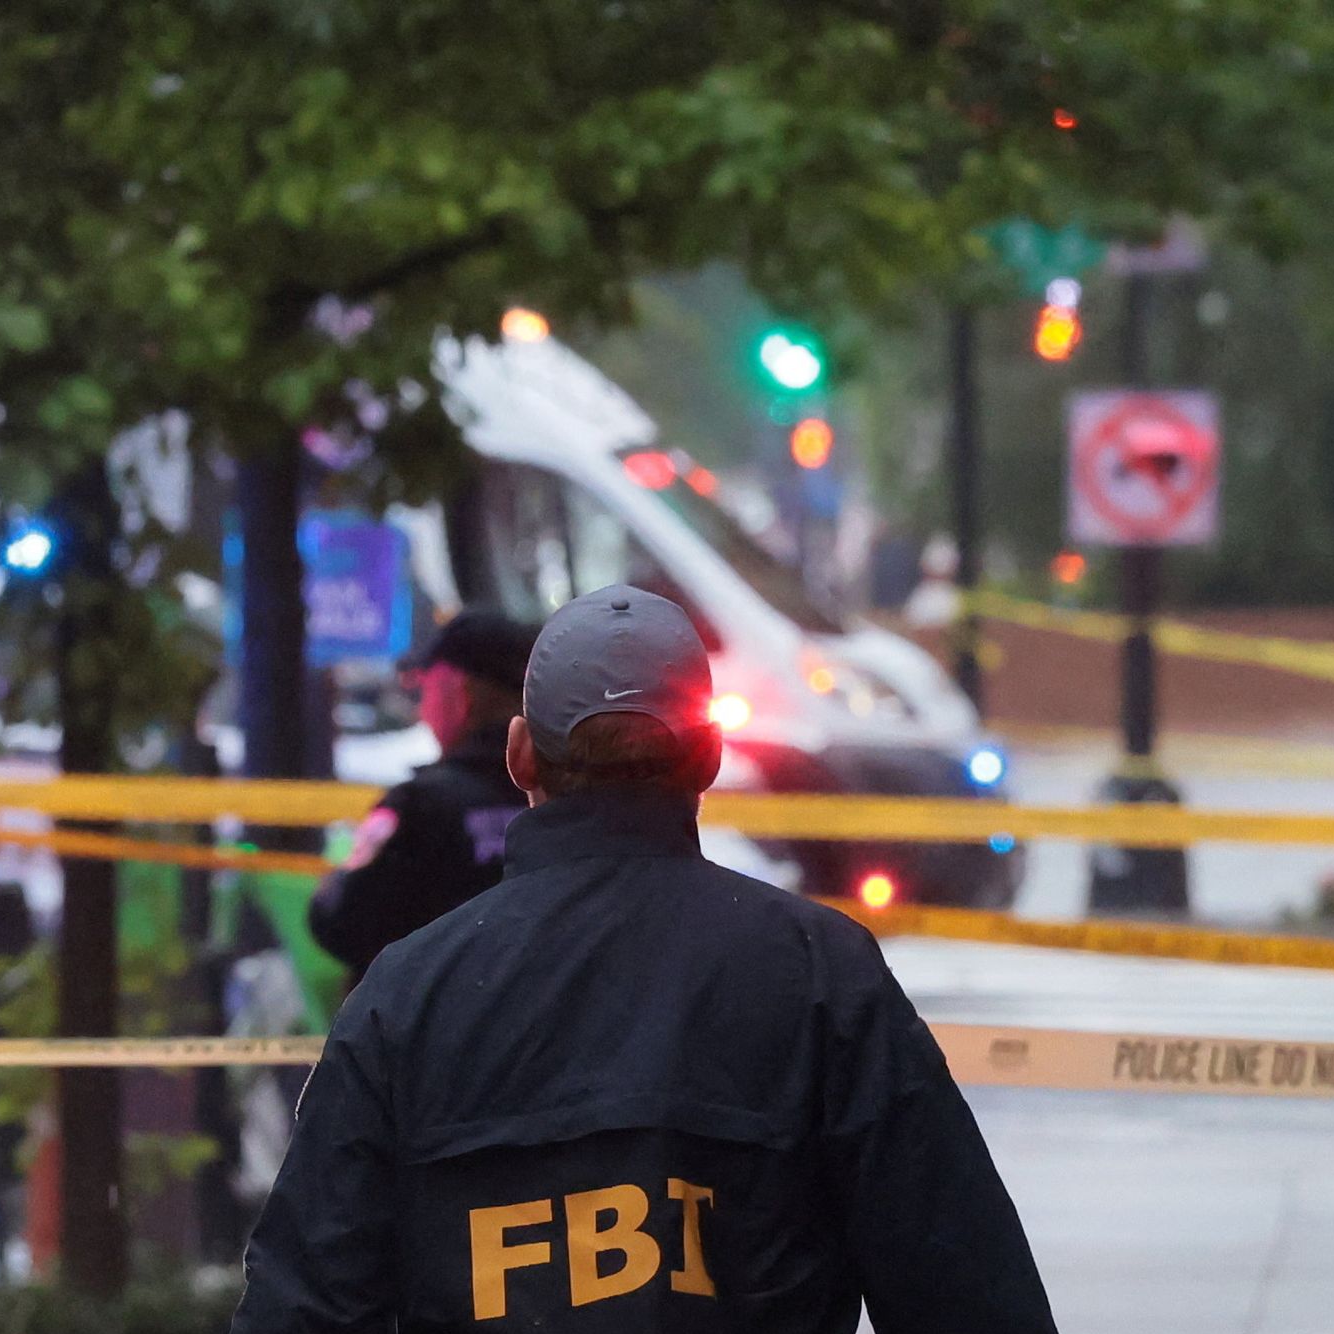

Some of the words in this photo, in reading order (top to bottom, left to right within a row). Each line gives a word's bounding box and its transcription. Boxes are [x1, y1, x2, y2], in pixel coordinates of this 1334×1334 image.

[1113, 1038, 1199, 1084] POLICE
[1207, 1043, 1261, 1086] LINE
[1269, 1044, 1307, 1087] DO
[469, 1177, 717, 1321] FBI
